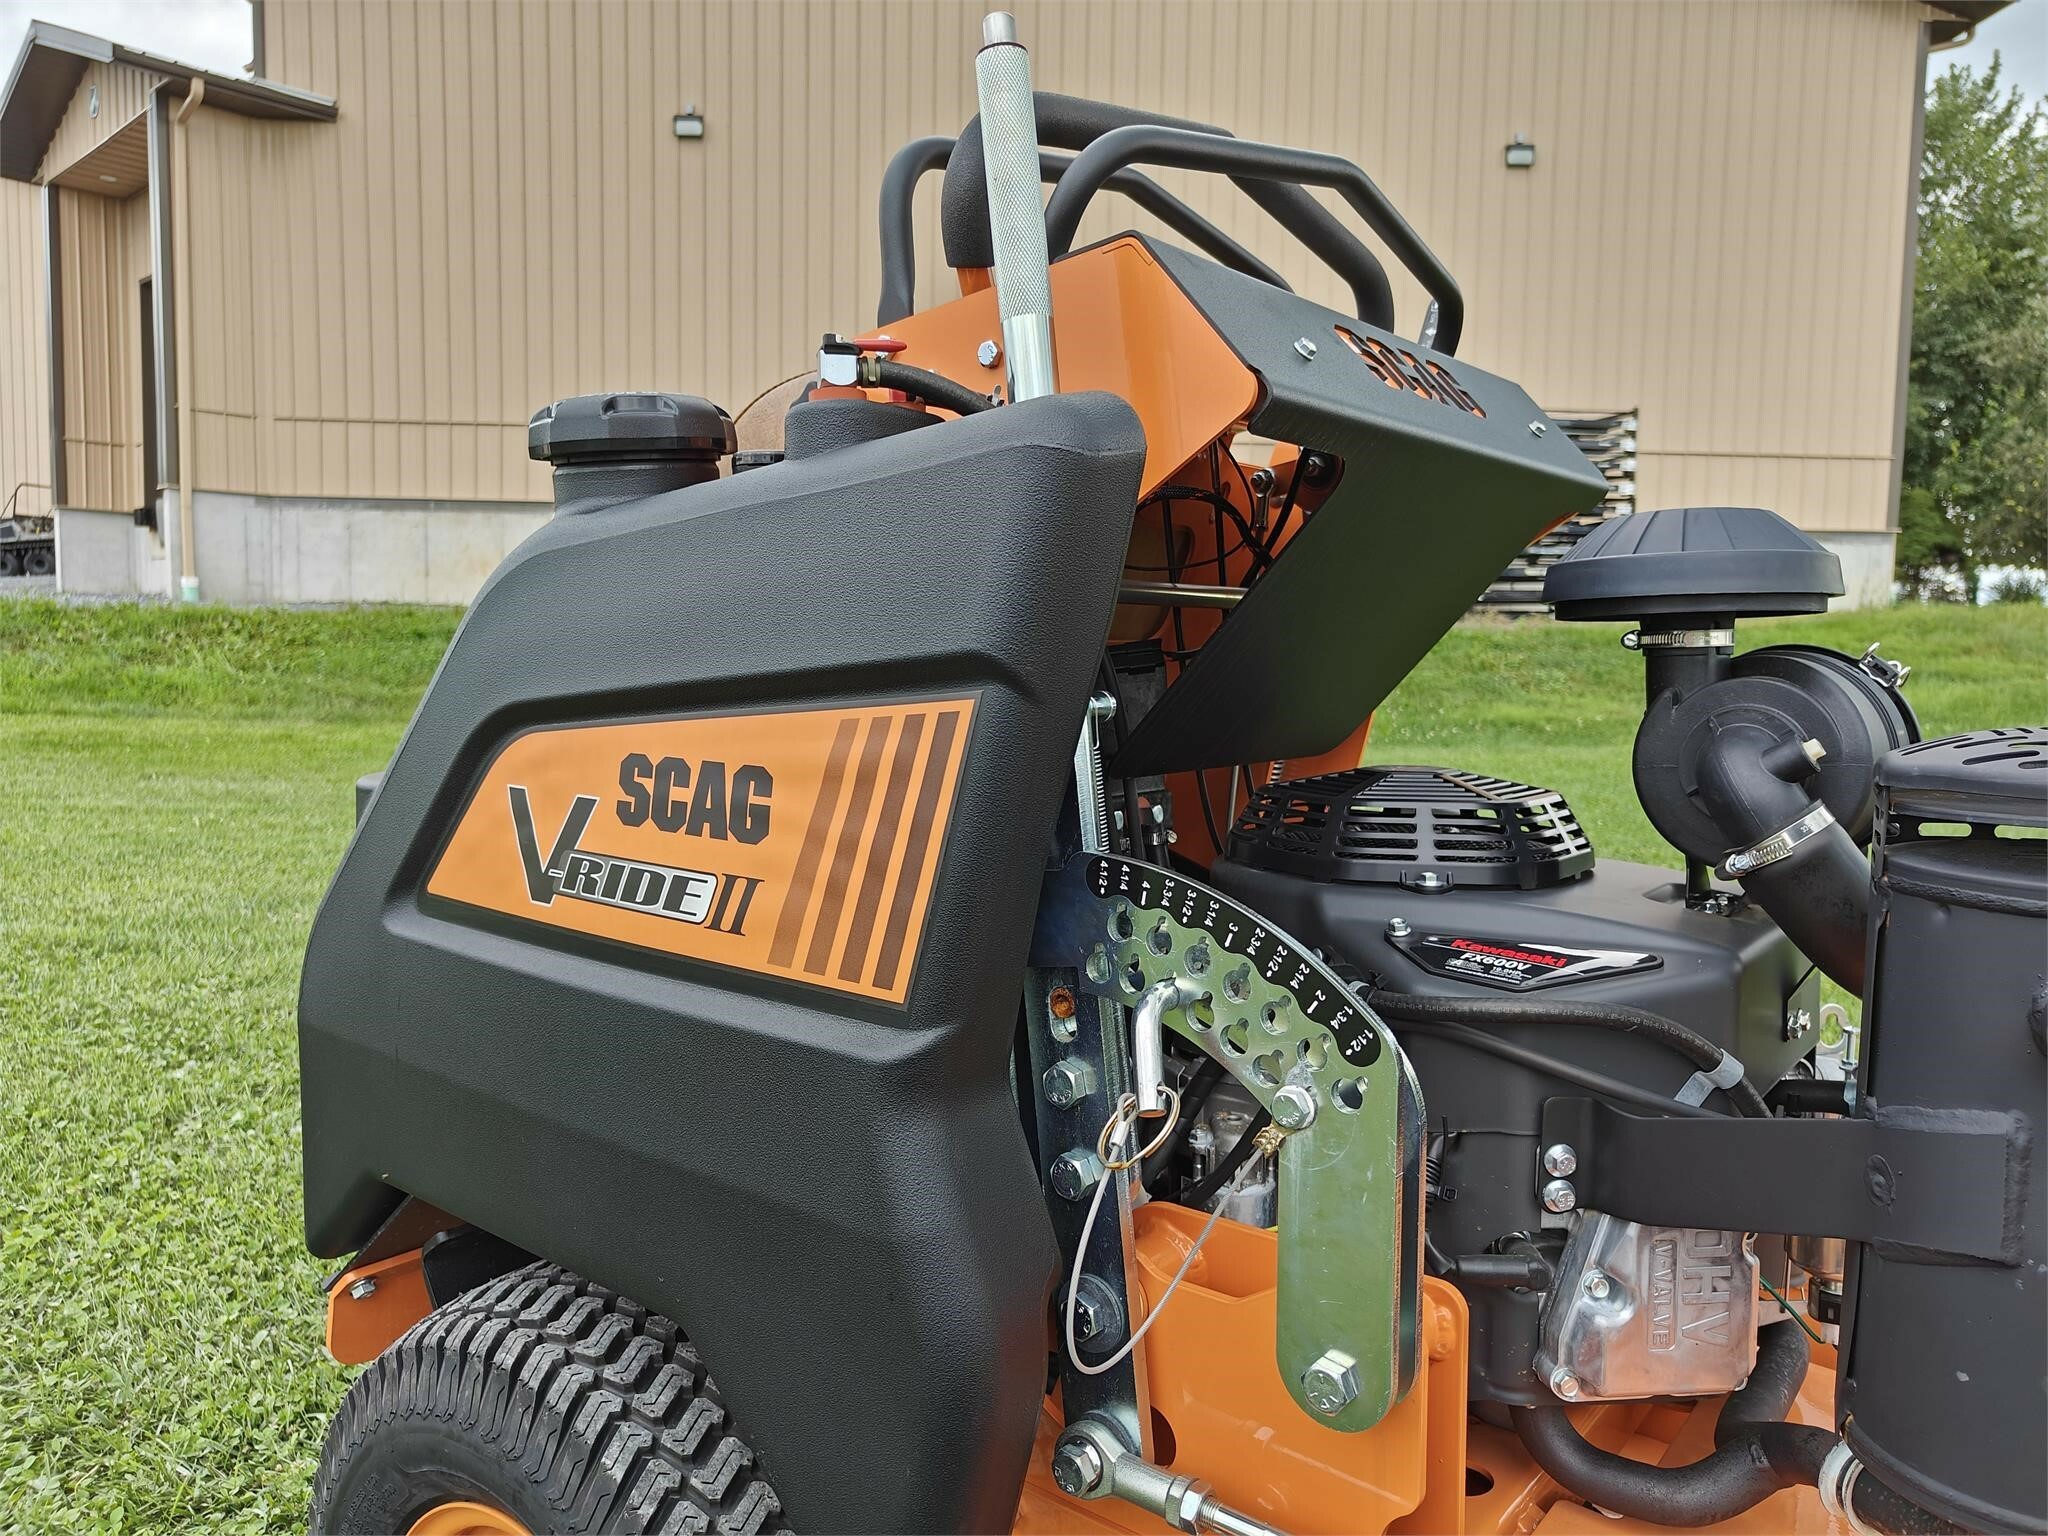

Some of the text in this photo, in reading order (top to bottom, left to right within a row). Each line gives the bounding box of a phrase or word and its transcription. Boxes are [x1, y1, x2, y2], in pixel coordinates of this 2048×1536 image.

[1334, 324, 1487, 418] SCAG
[616, 752, 773, 845] SCAG
[1098, 860, 1108, 886] 4-1/2
[1119, 864, 1130, 891] 4-1/4
[1141, 880, 1151, 889] 4
[704, 873, 765, 936] II
[1160, 879, 1175, 907] 3-3/4
[1182, 889, 1197, 916] 3-1/2
[1203, 900, 1220, 927] 3-1/4
[1228, 922, 1239, 932] 3
[1246, 927, 1266, 956] 2-3/4
[1450, 939, 1568, 968] Kawasaki
[1267, 945, 1288, 971] 2-1/2
[1460, 952, 1532, 971] FX600V
[1289, 963, 1310, 989] 2-1/4
[1315, 989, 1326, 1001] 2
[1330, 1005, 1353, 1029] 1-3/4
[1350, 1029, 1374, 1051] 1-1/2
